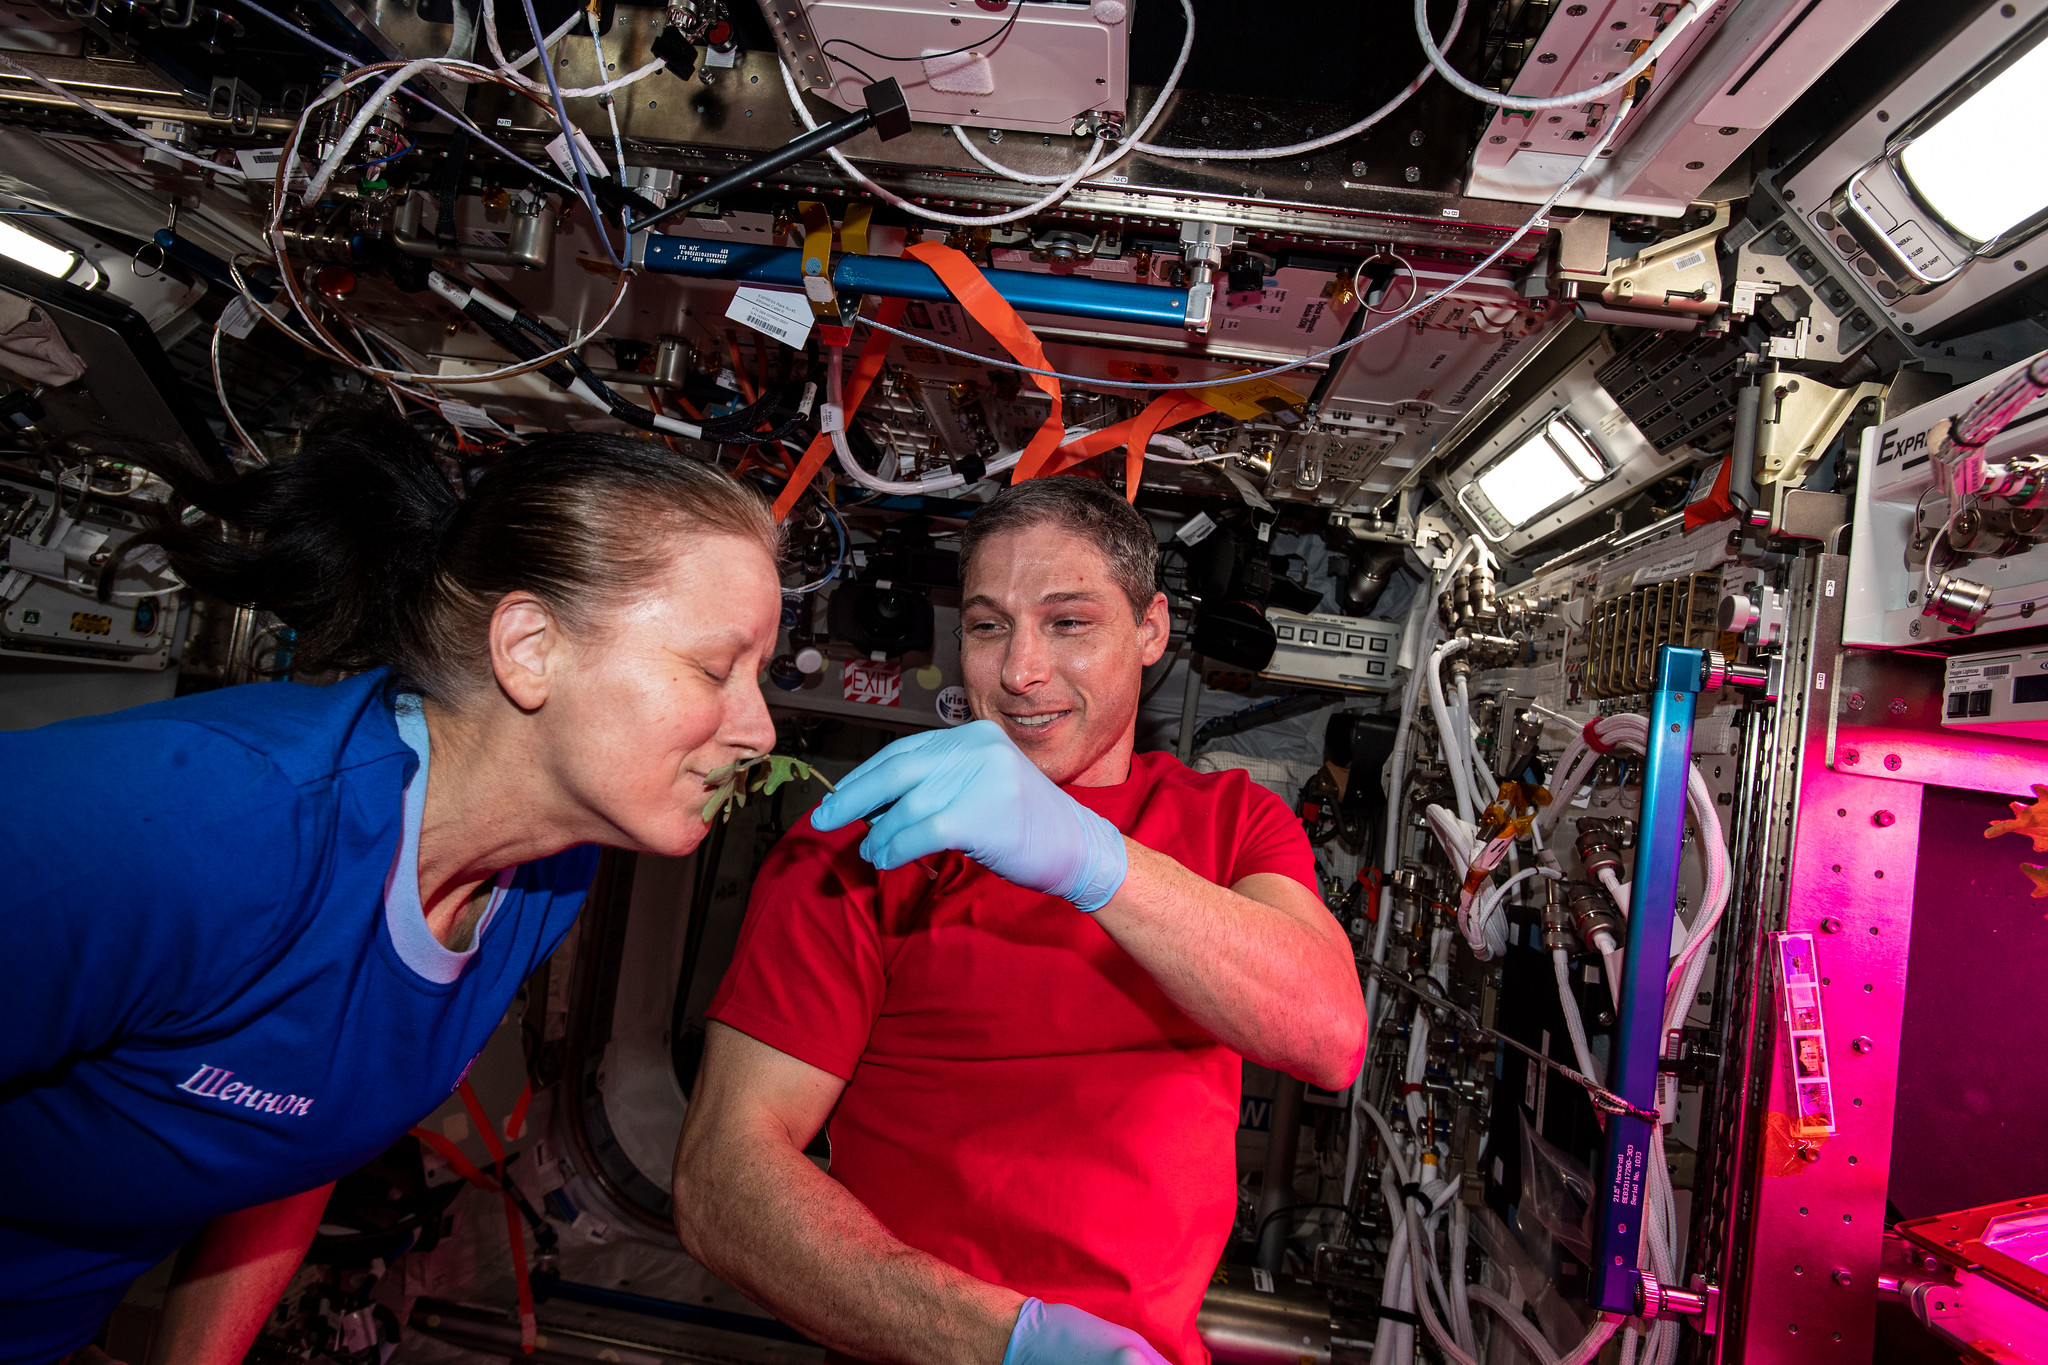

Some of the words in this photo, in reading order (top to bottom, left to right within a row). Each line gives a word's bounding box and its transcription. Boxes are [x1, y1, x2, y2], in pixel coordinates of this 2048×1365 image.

[1896, 236, 1912, 248] ENERAL
[1907, 247, 1924, 260] E-SLEEP
[1919, 256, 1941, 272] ASE-SHIFT
[852, 669, 892, 695] EXIT
[176, 1063, 315, 1116] Шеннон
[1634, 1151, 1642, 1168] 1033
[1615, 1153, 1625, 1184] Handrail
[1632, 1170, 1640, 1181] No.
[1630, 1184, 1639, 1206] Serial
